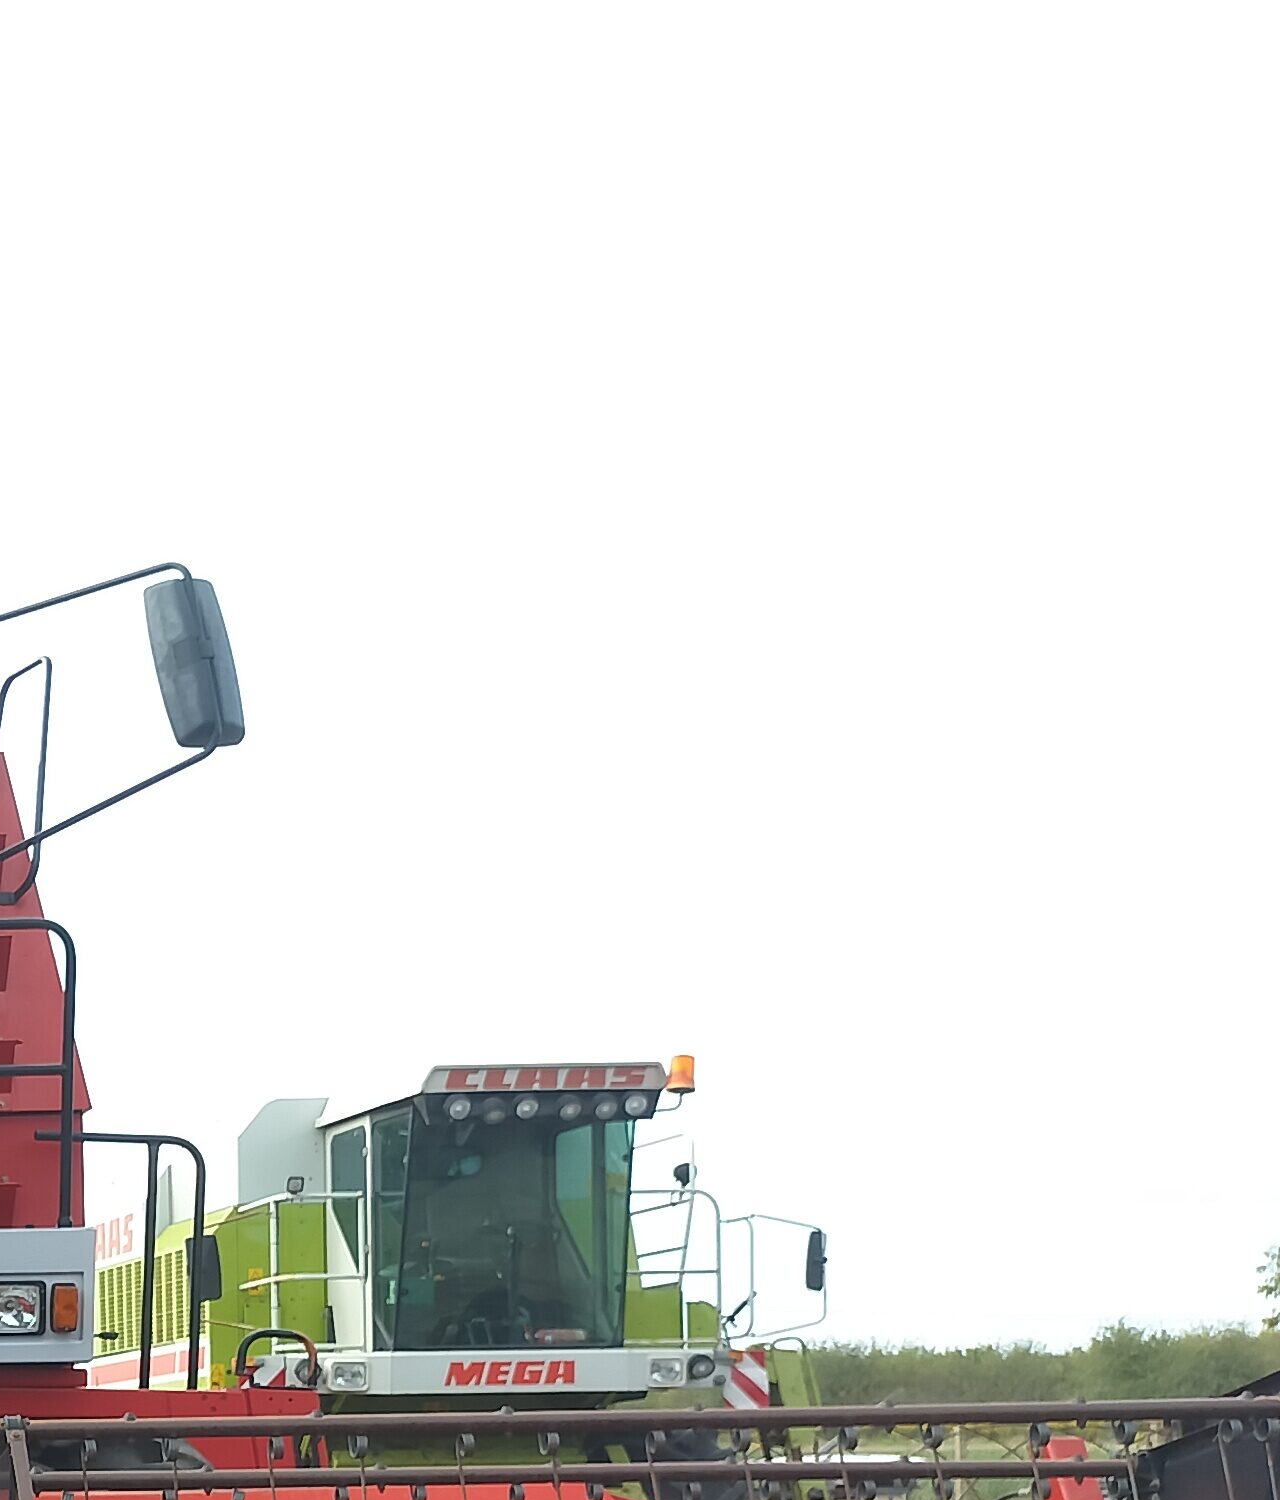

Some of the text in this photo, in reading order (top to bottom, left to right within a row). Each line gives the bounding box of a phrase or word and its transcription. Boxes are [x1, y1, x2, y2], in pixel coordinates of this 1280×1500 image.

[446, 1067, 646, 1090] CLAAS
[95, 1213, 133, 1261] AAS
[445, 1361, 575, 1386] MEGA
